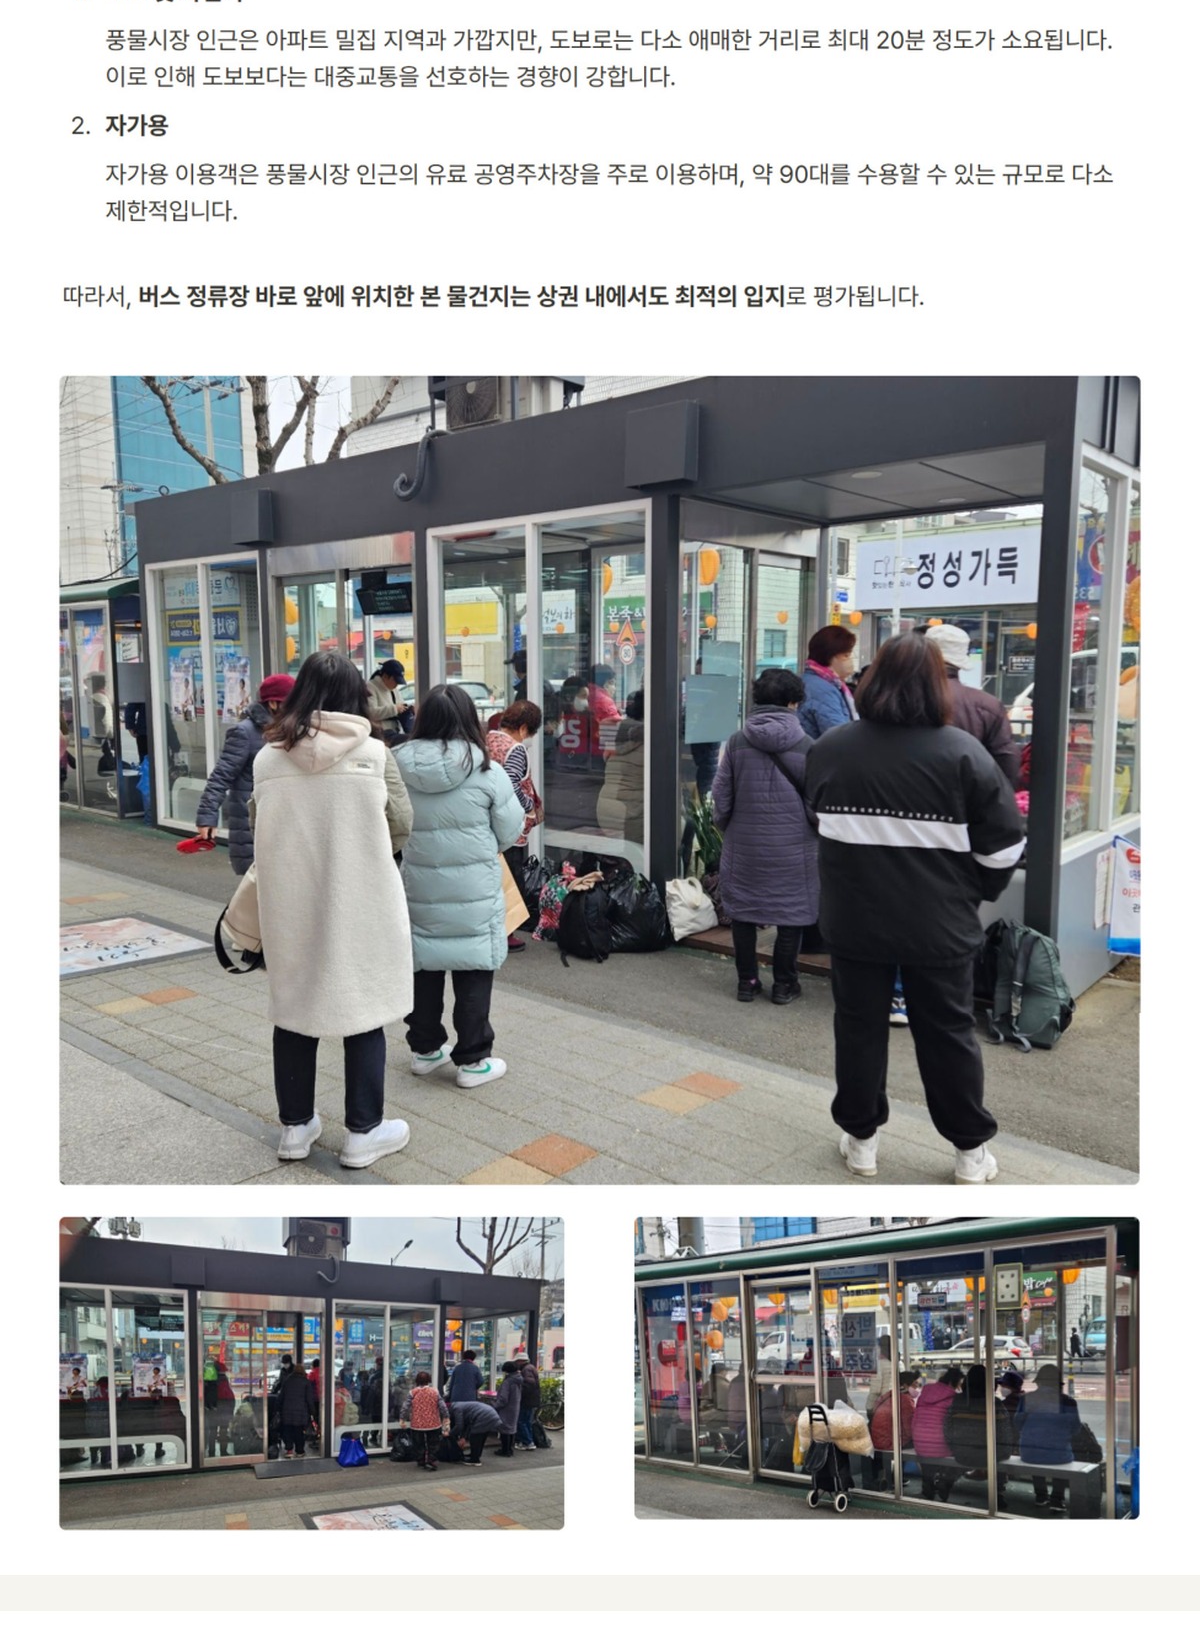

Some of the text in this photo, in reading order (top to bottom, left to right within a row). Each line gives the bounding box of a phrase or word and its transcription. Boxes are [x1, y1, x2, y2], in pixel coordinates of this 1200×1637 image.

[72, 114, 168, 136] 2. 자가용
[106, 200, 237, 222] 제한적입니다.
[917, 546, 1019, 589] 정성가득
